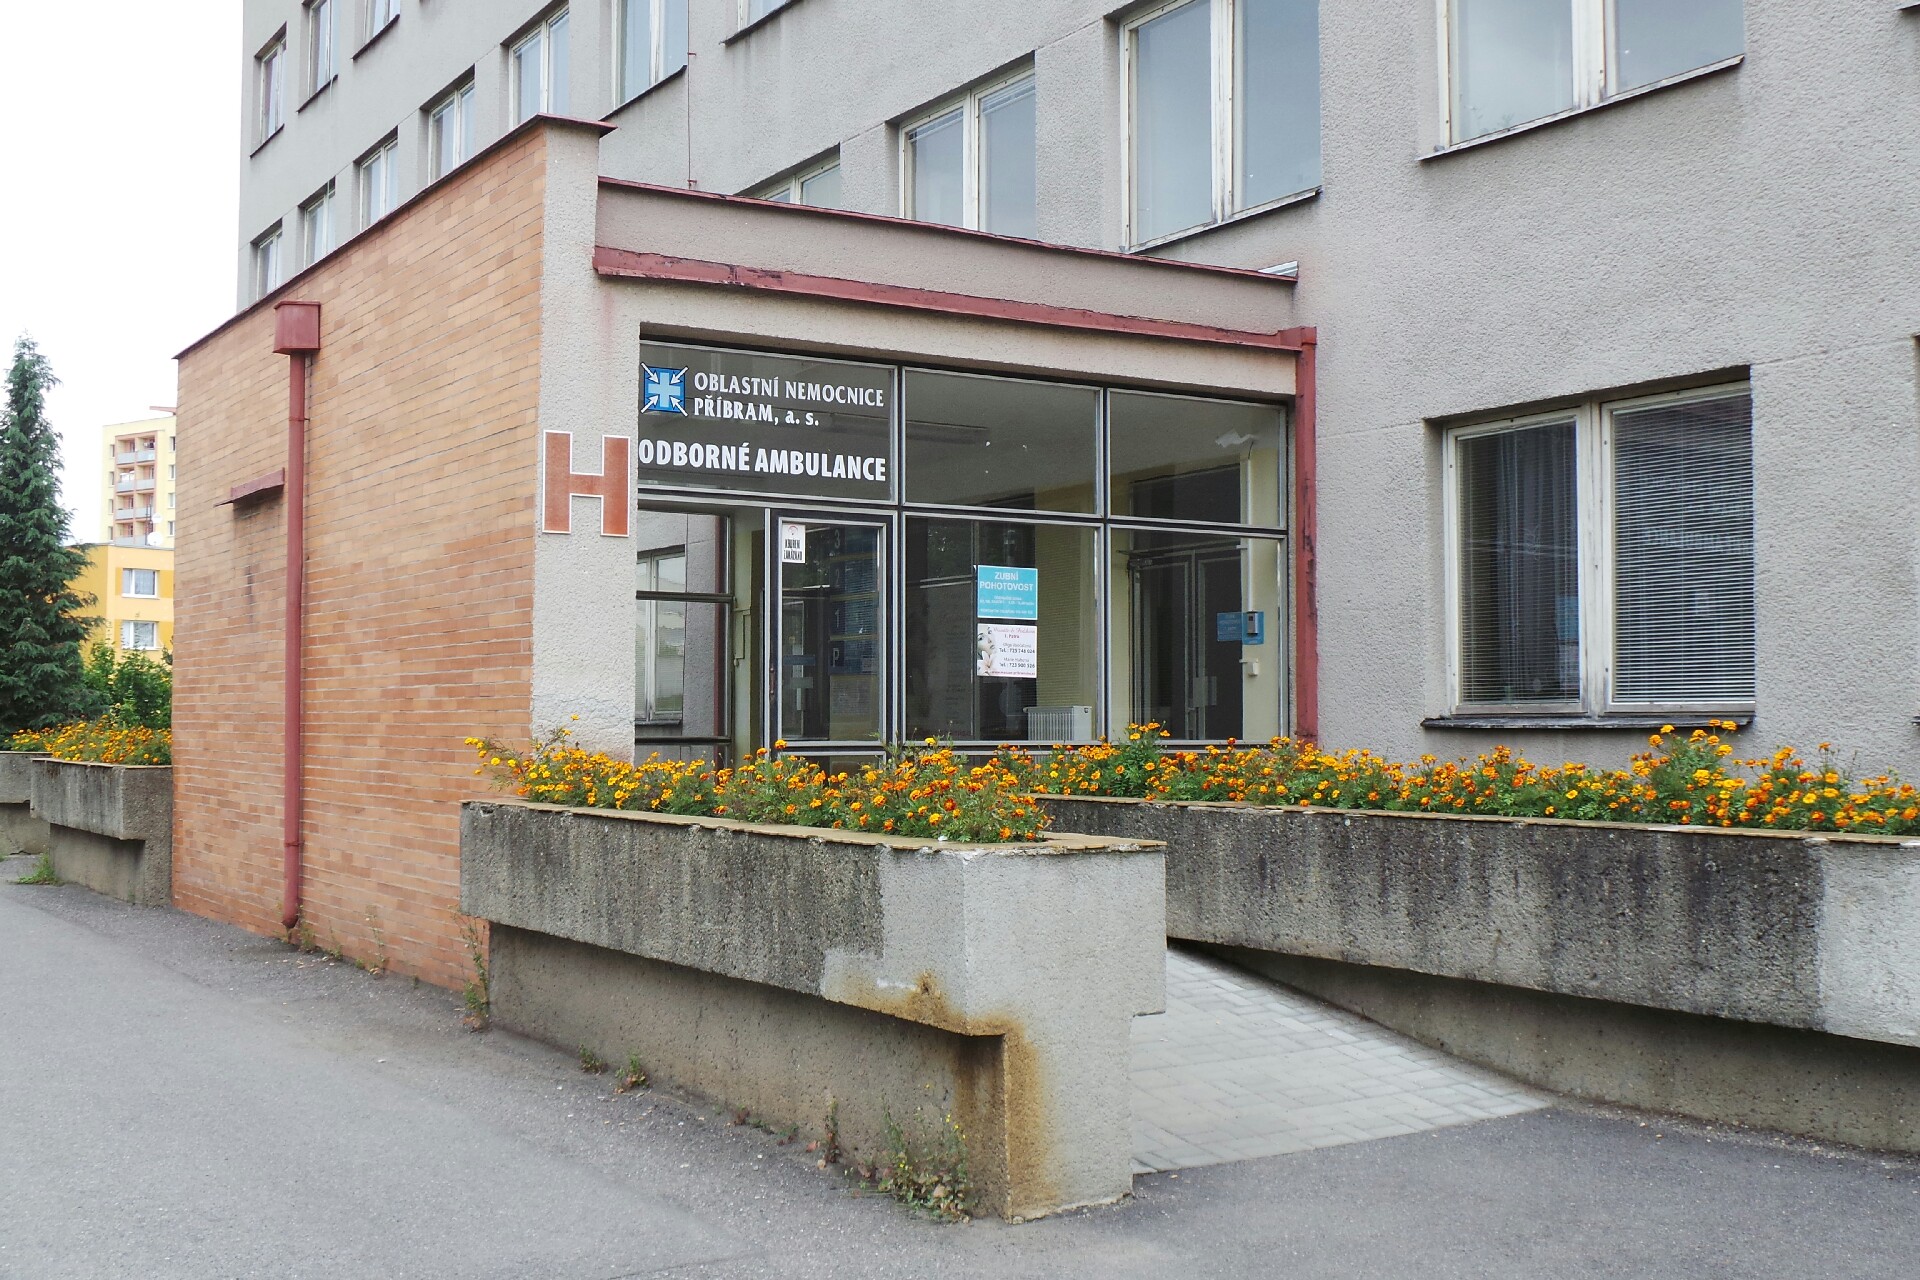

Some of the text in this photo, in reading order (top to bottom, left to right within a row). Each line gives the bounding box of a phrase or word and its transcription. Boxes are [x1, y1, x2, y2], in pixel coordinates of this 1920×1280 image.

[694, 371, 885, 407] OBLASTNÍ NEMOCNICE
[694, 394, 819, 426] PŘÍBRAM, a. s.
[638, 438, 886, 482] ODBORNÉ AMBULANCE
[542, 430, 630, 537] H
[980, 581, 1034, 592] POHOTOVOST
[994, 571, 1019, 581] ZUBNÍ
